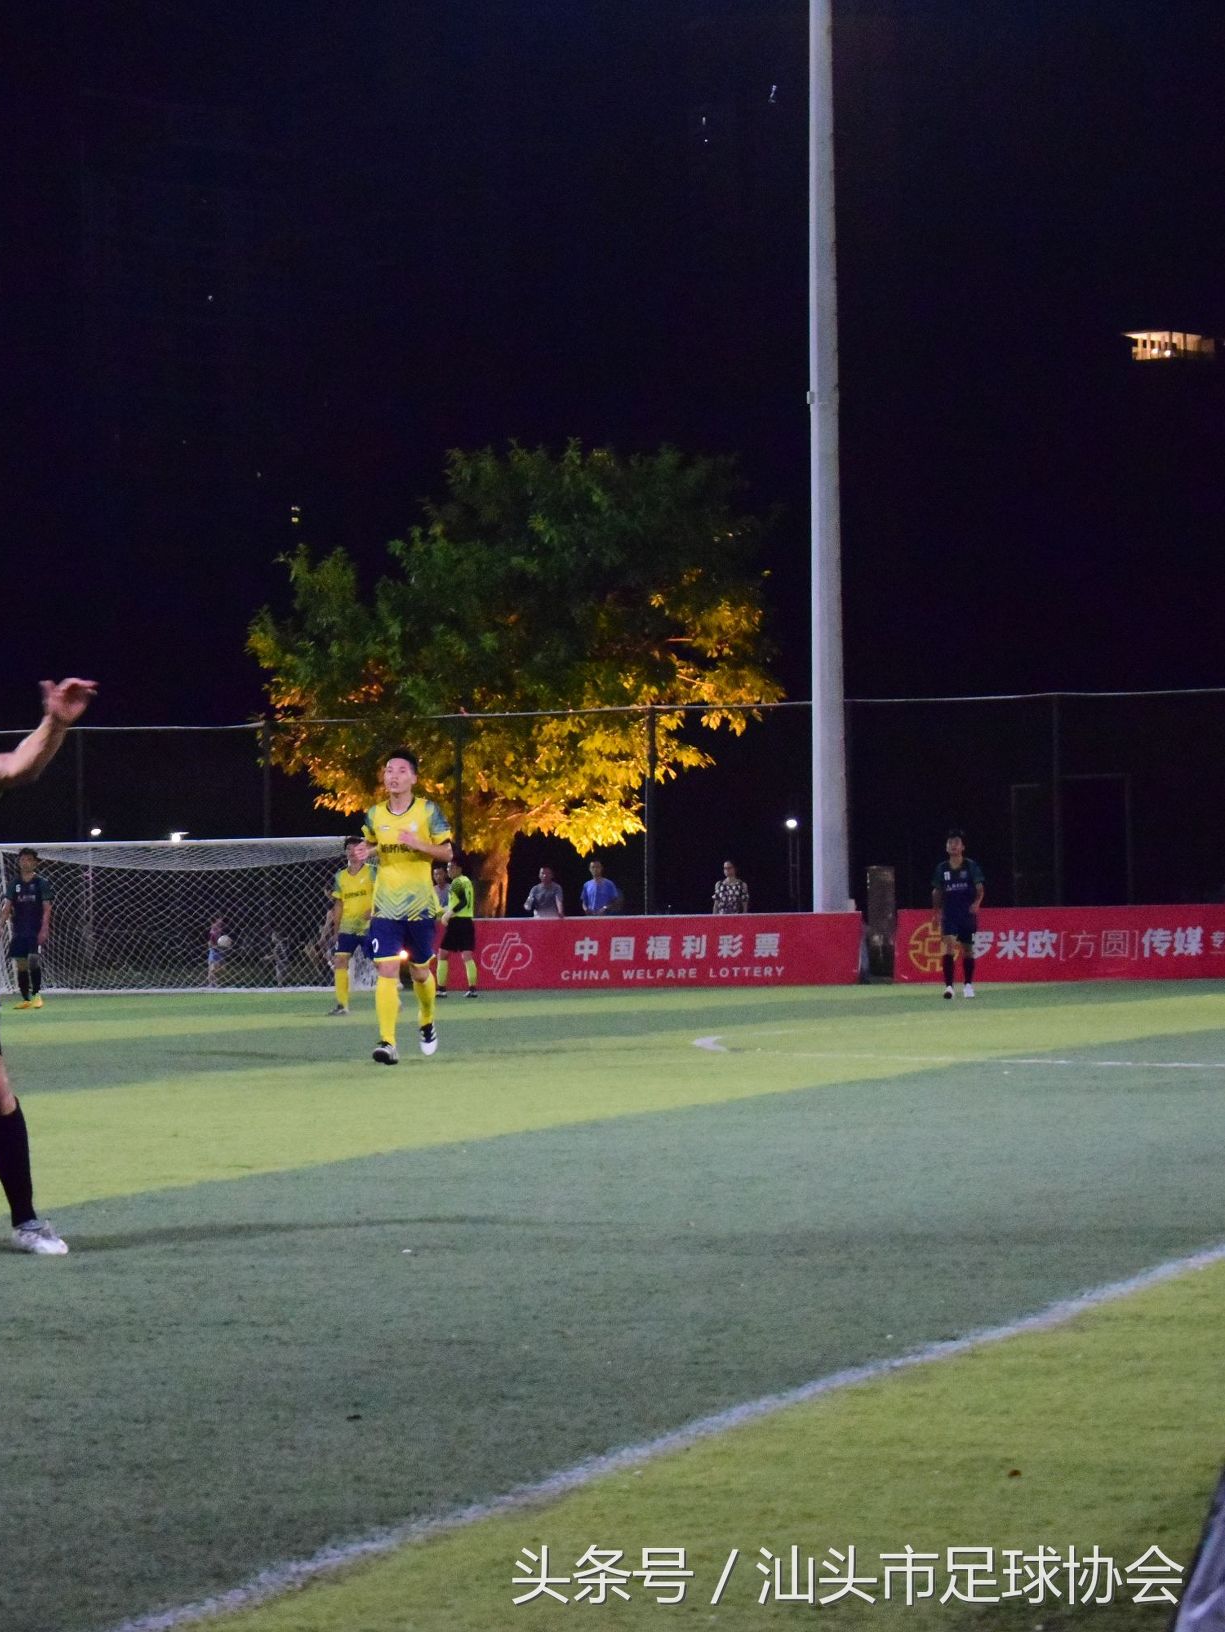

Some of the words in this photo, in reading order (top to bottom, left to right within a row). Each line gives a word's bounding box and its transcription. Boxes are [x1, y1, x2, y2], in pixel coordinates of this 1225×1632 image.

[575, 933, 780, 961] 中国福利彩票
[561, 969, 610, 981] CHINA
[623, 968, 697, 979] WELFARE
[710, 966, 785, 978] LOTTERY
